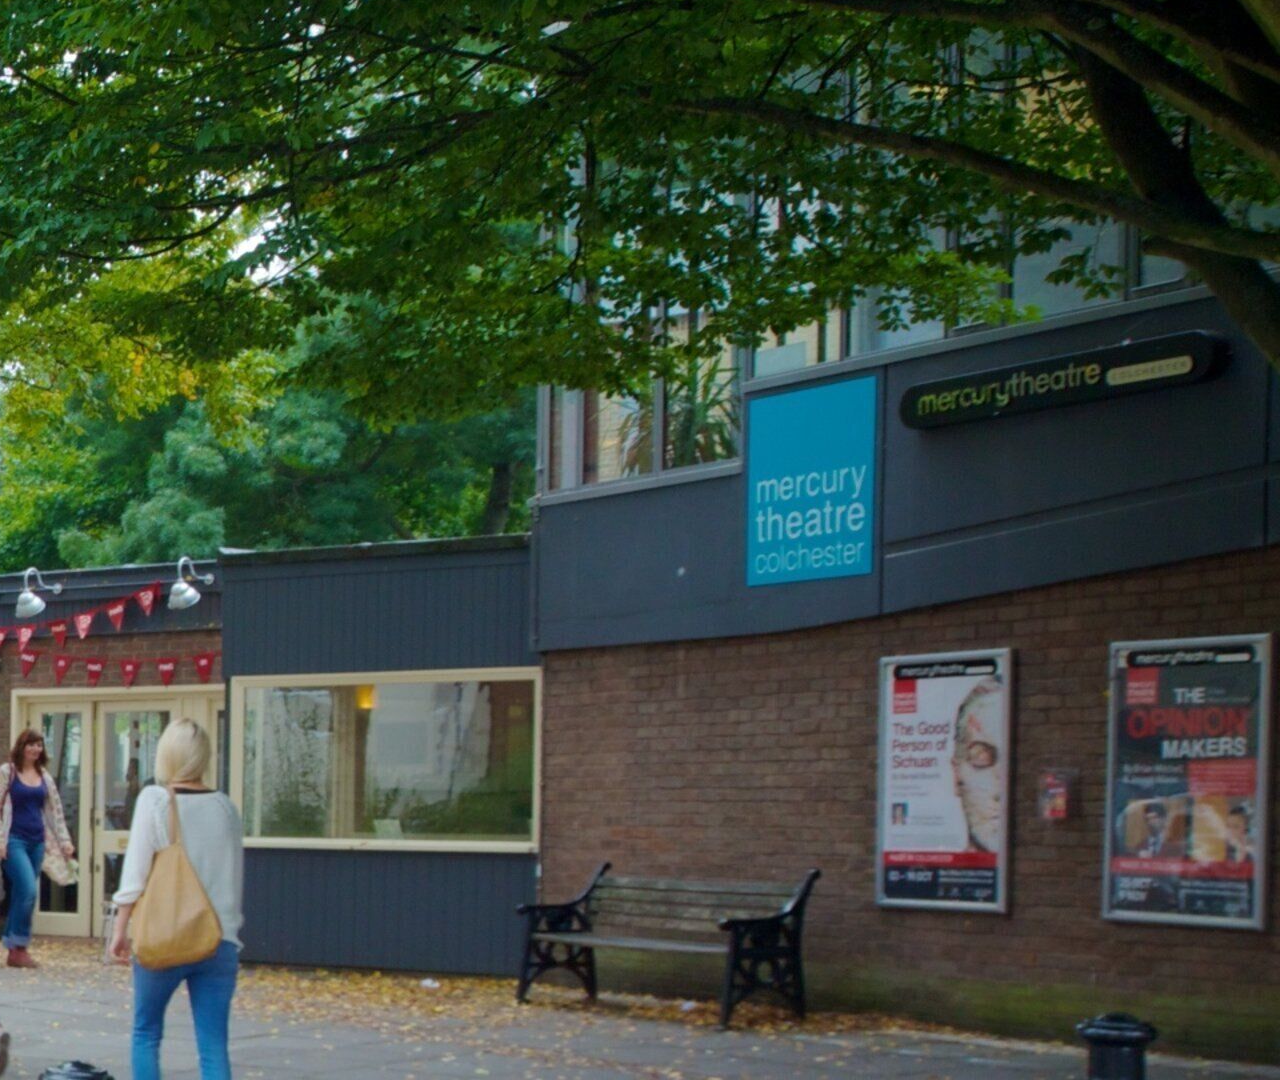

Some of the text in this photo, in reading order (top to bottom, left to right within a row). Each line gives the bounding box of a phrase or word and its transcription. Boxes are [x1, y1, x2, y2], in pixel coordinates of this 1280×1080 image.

[756, 465, 867, 503] mercury
[755, 500, 866, 543] theatre
[755, 542, 865, 574] colchester
[1174, 687, 1206, 704] THE
[893, 722, 950, 736] The Good
[1127, 706, 1252, 740] OPINION
[893, 737, 948, 753] Person of
[1162, 736, 1247, 760] MAKERS
